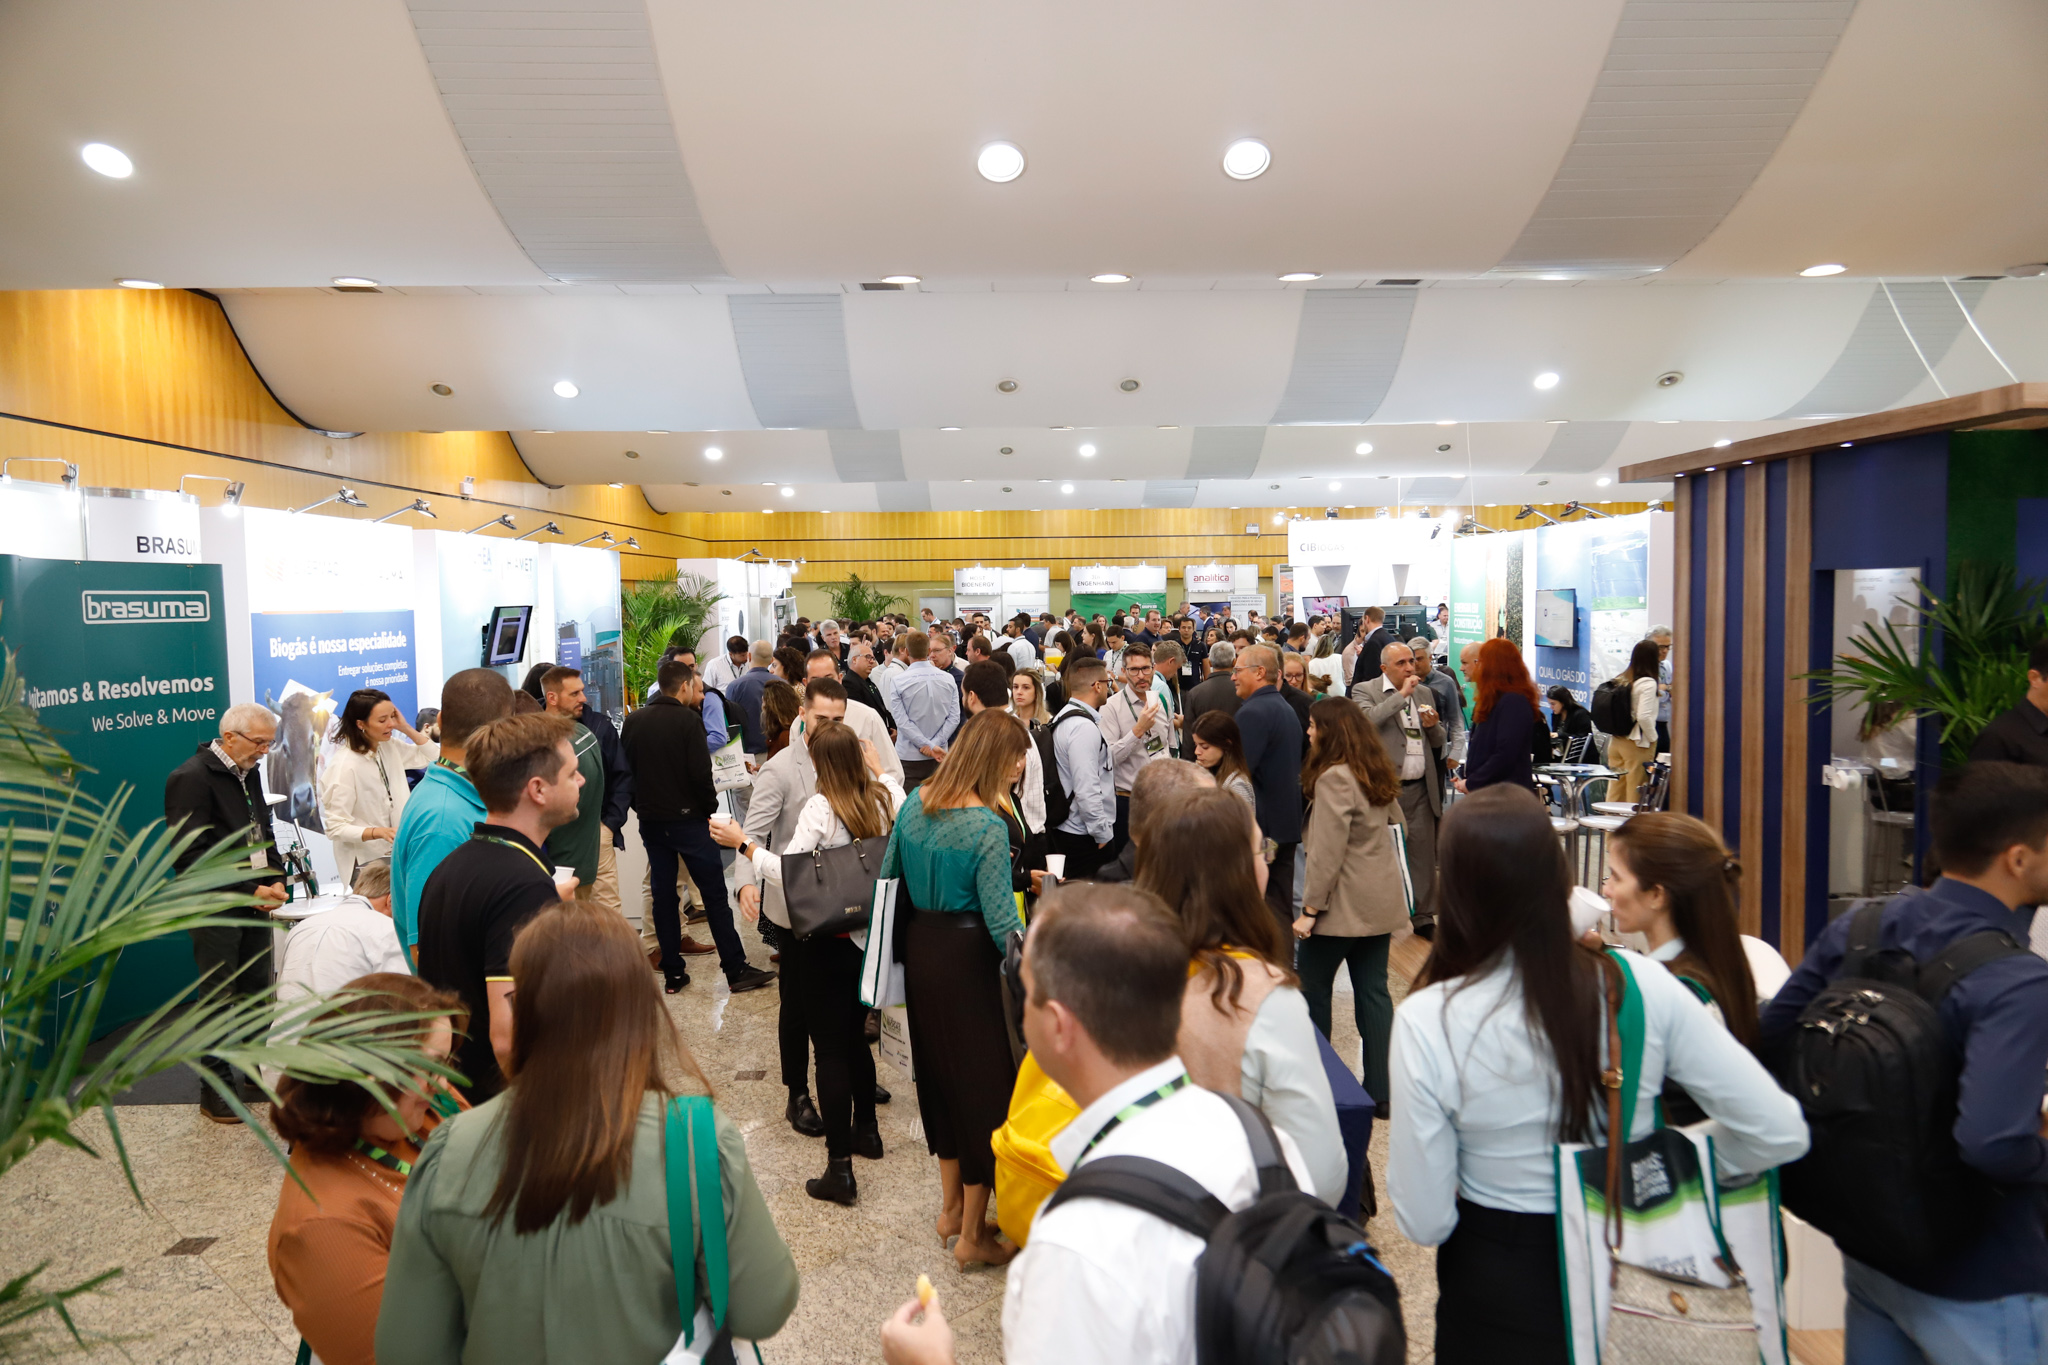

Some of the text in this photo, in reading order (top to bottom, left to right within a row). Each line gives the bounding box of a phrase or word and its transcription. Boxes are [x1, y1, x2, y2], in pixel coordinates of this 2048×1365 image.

[87, 595, 205, 619] brasuma
[269, 630, 407, 661] Biogás é nossa especialidade
[338, 659, 408, 677] Entregar soluções completas
[365, 672, 409, 687] é nossa prioridade
[1538, 666, 1556, 680] QUAL
[1555, 668, 1562, 681] O
[1575, 671, 1586, 684] DO
[82, 682, 94, 702] &
[98, 675, 214, 700] Resolvemos
[91, 708, 216, 732] We Solve & Move
